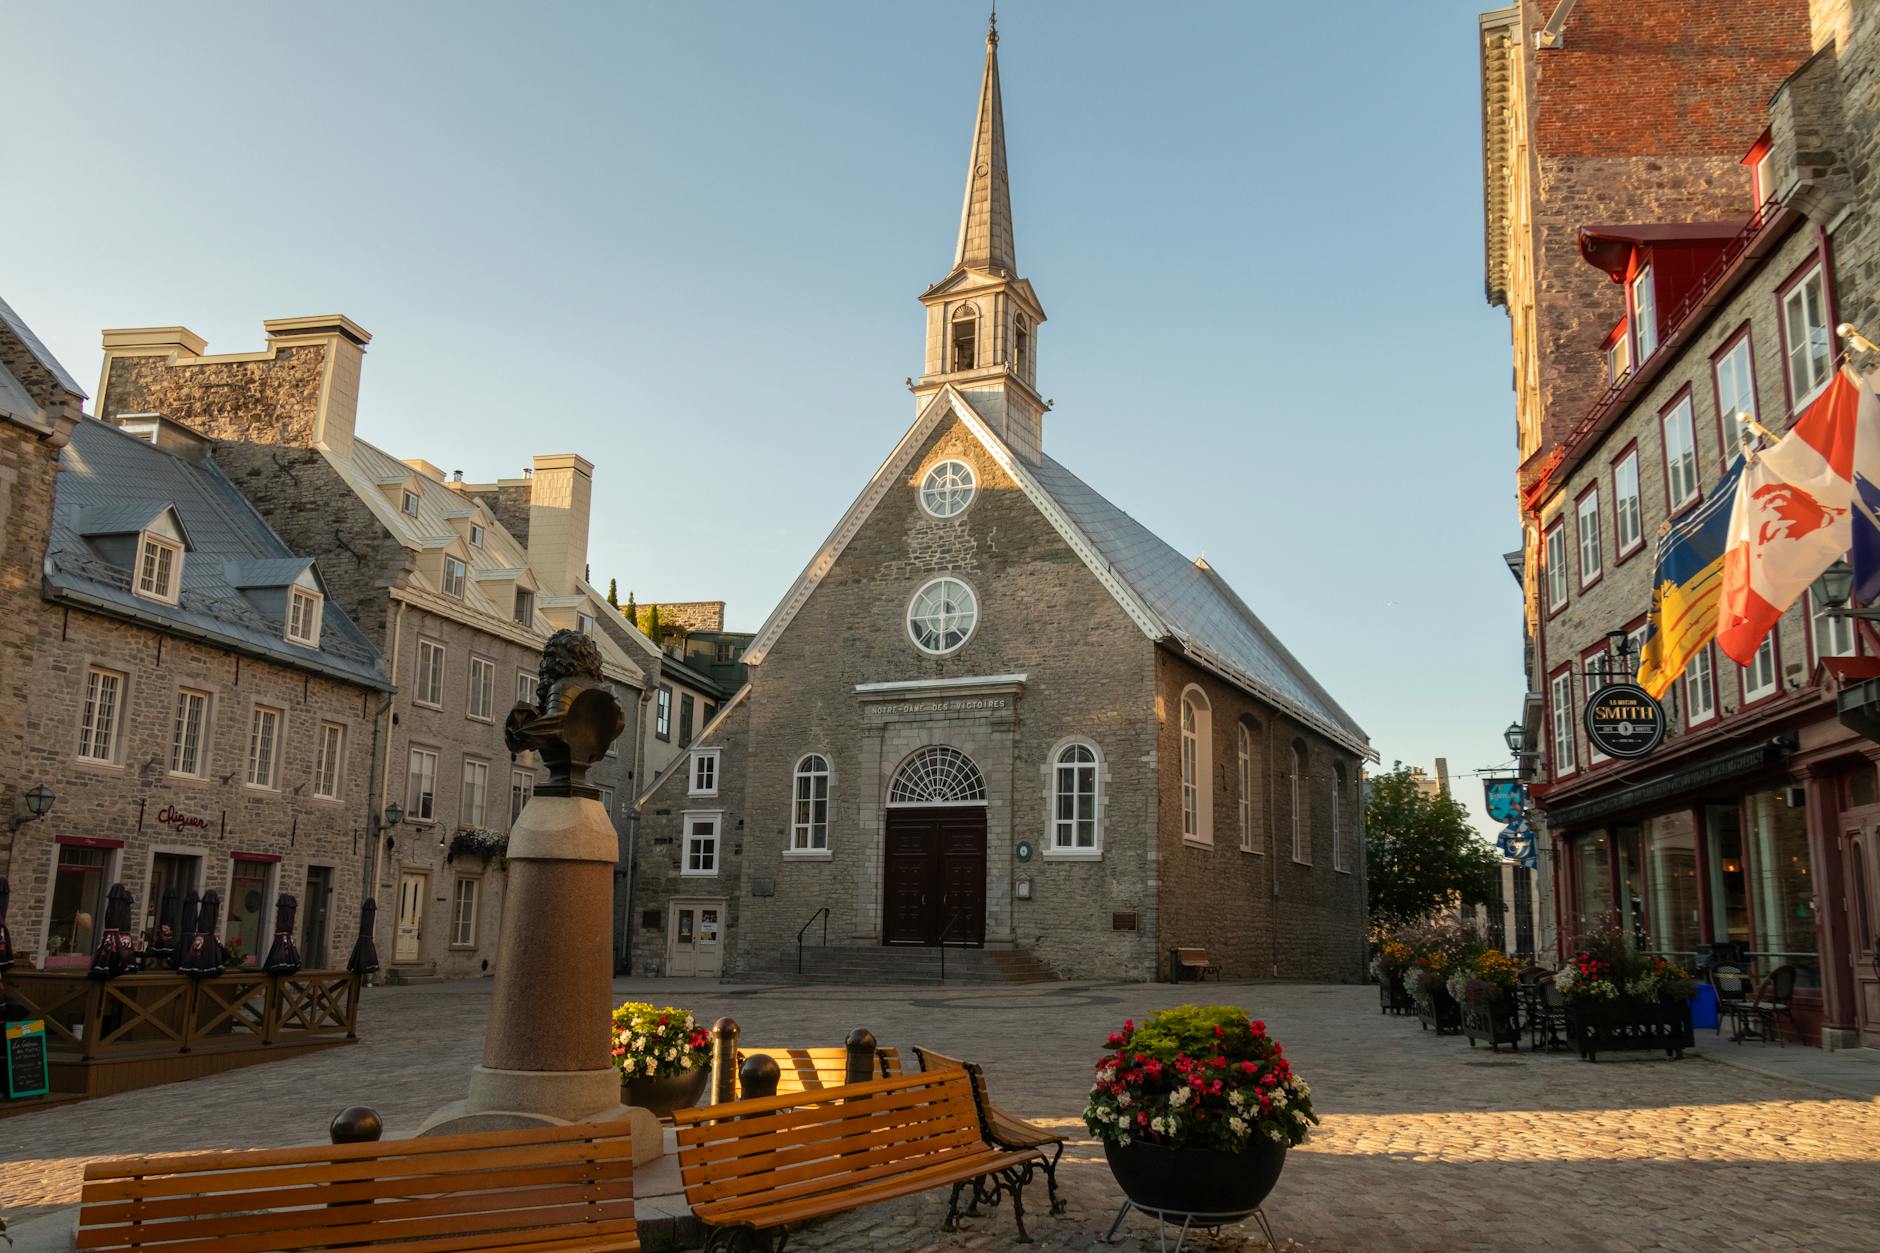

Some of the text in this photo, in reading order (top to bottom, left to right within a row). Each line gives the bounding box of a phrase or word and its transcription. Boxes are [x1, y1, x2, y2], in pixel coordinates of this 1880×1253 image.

[932, 703, 948, 711] DES
[956, 700, 1005, 710] VICTOIRES
[1595, 707, 1654, 720] SMITH
